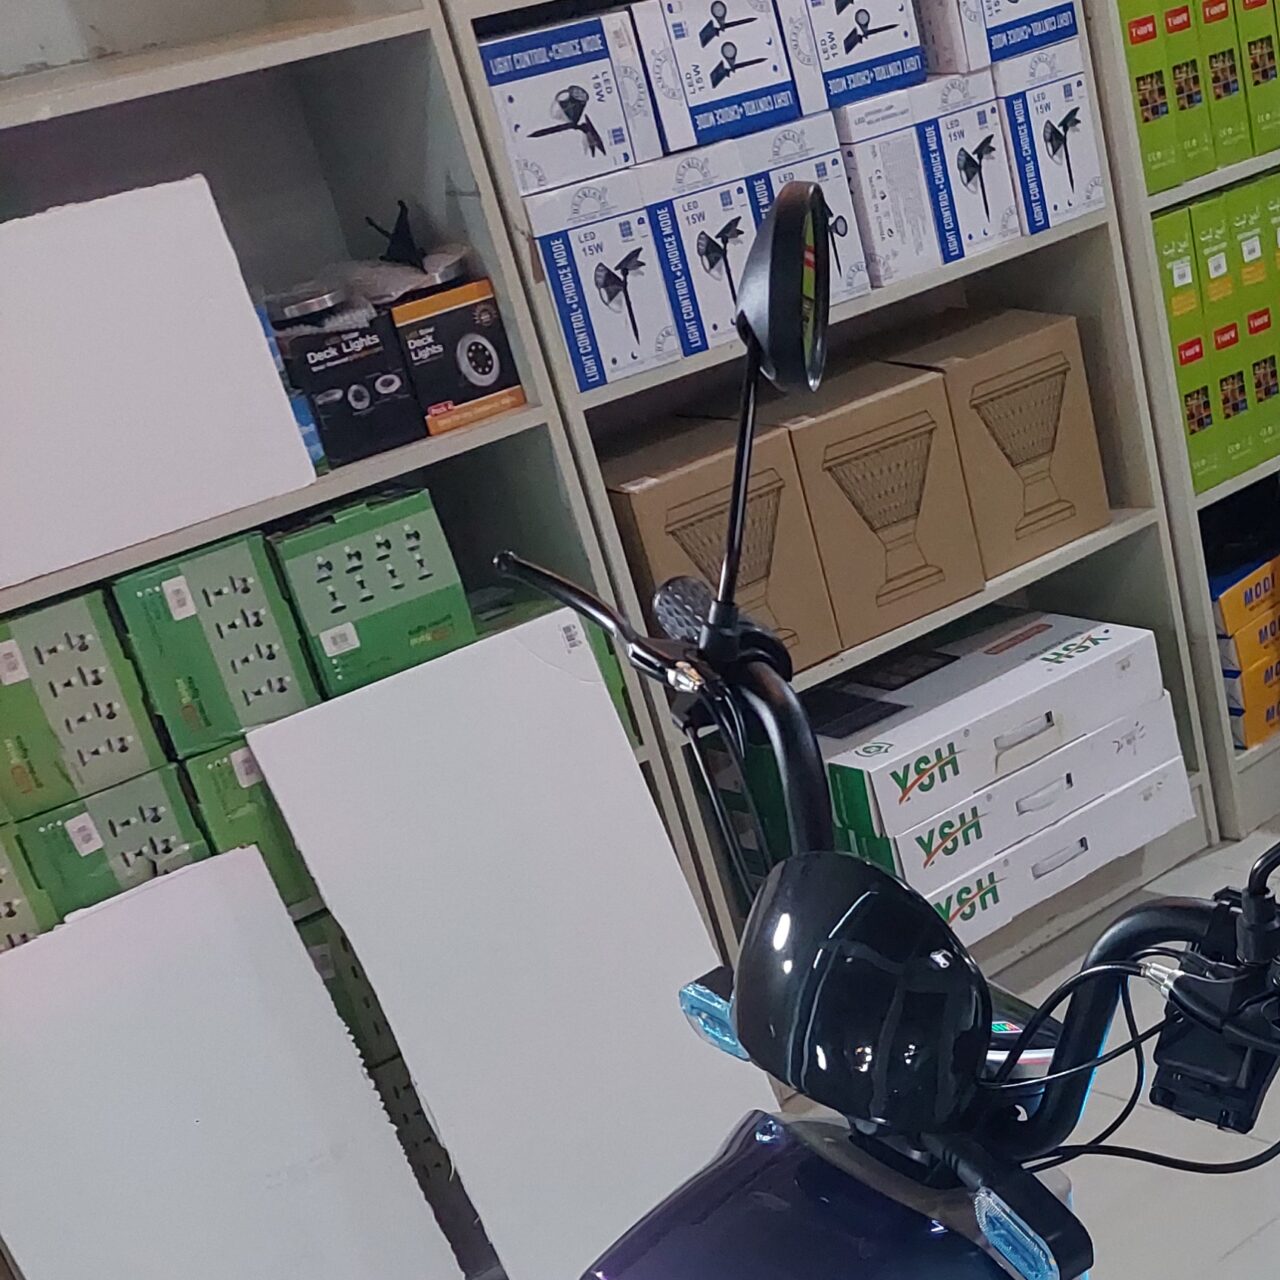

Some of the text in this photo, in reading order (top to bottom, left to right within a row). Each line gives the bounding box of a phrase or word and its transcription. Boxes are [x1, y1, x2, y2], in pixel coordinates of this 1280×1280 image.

[820, 39, 830, 61] LED
[601, 71, 613, 95] LED
[685, 72, 696, 95] LED
[1013, 98, 1025, 123] MODE
[925, 125, 938, 151] MODE
[947, 130, 965, 143] 15W
[778, 172, 795, 183] LED
[682, 201, 699, 212] LED
[1031, 199, 1045, 227] LIGHT
[657, 206, 672, 233] MODE
[685, 212, 706, 227] 15W
[578, 231, 596, 244] LED
[582, 243, 604, 257] 15W
[551, 237, 567, 267] MODE
[407, 334, 434, 350] Deck
[685, 320, 702, 348] LIGHT
[306, 347, 339, 364] Deck
[341, 334, 380, 354] Lights
[410, 344, 444, 361] Lights
[581, 355, 599, 382] LIGHT
[1243, 572, 1276, 608] MODI
[889, 742, 963, 804] YSH
[915, 806, 987, 868] YSH
[933, 871, 1001, 924] YSH
